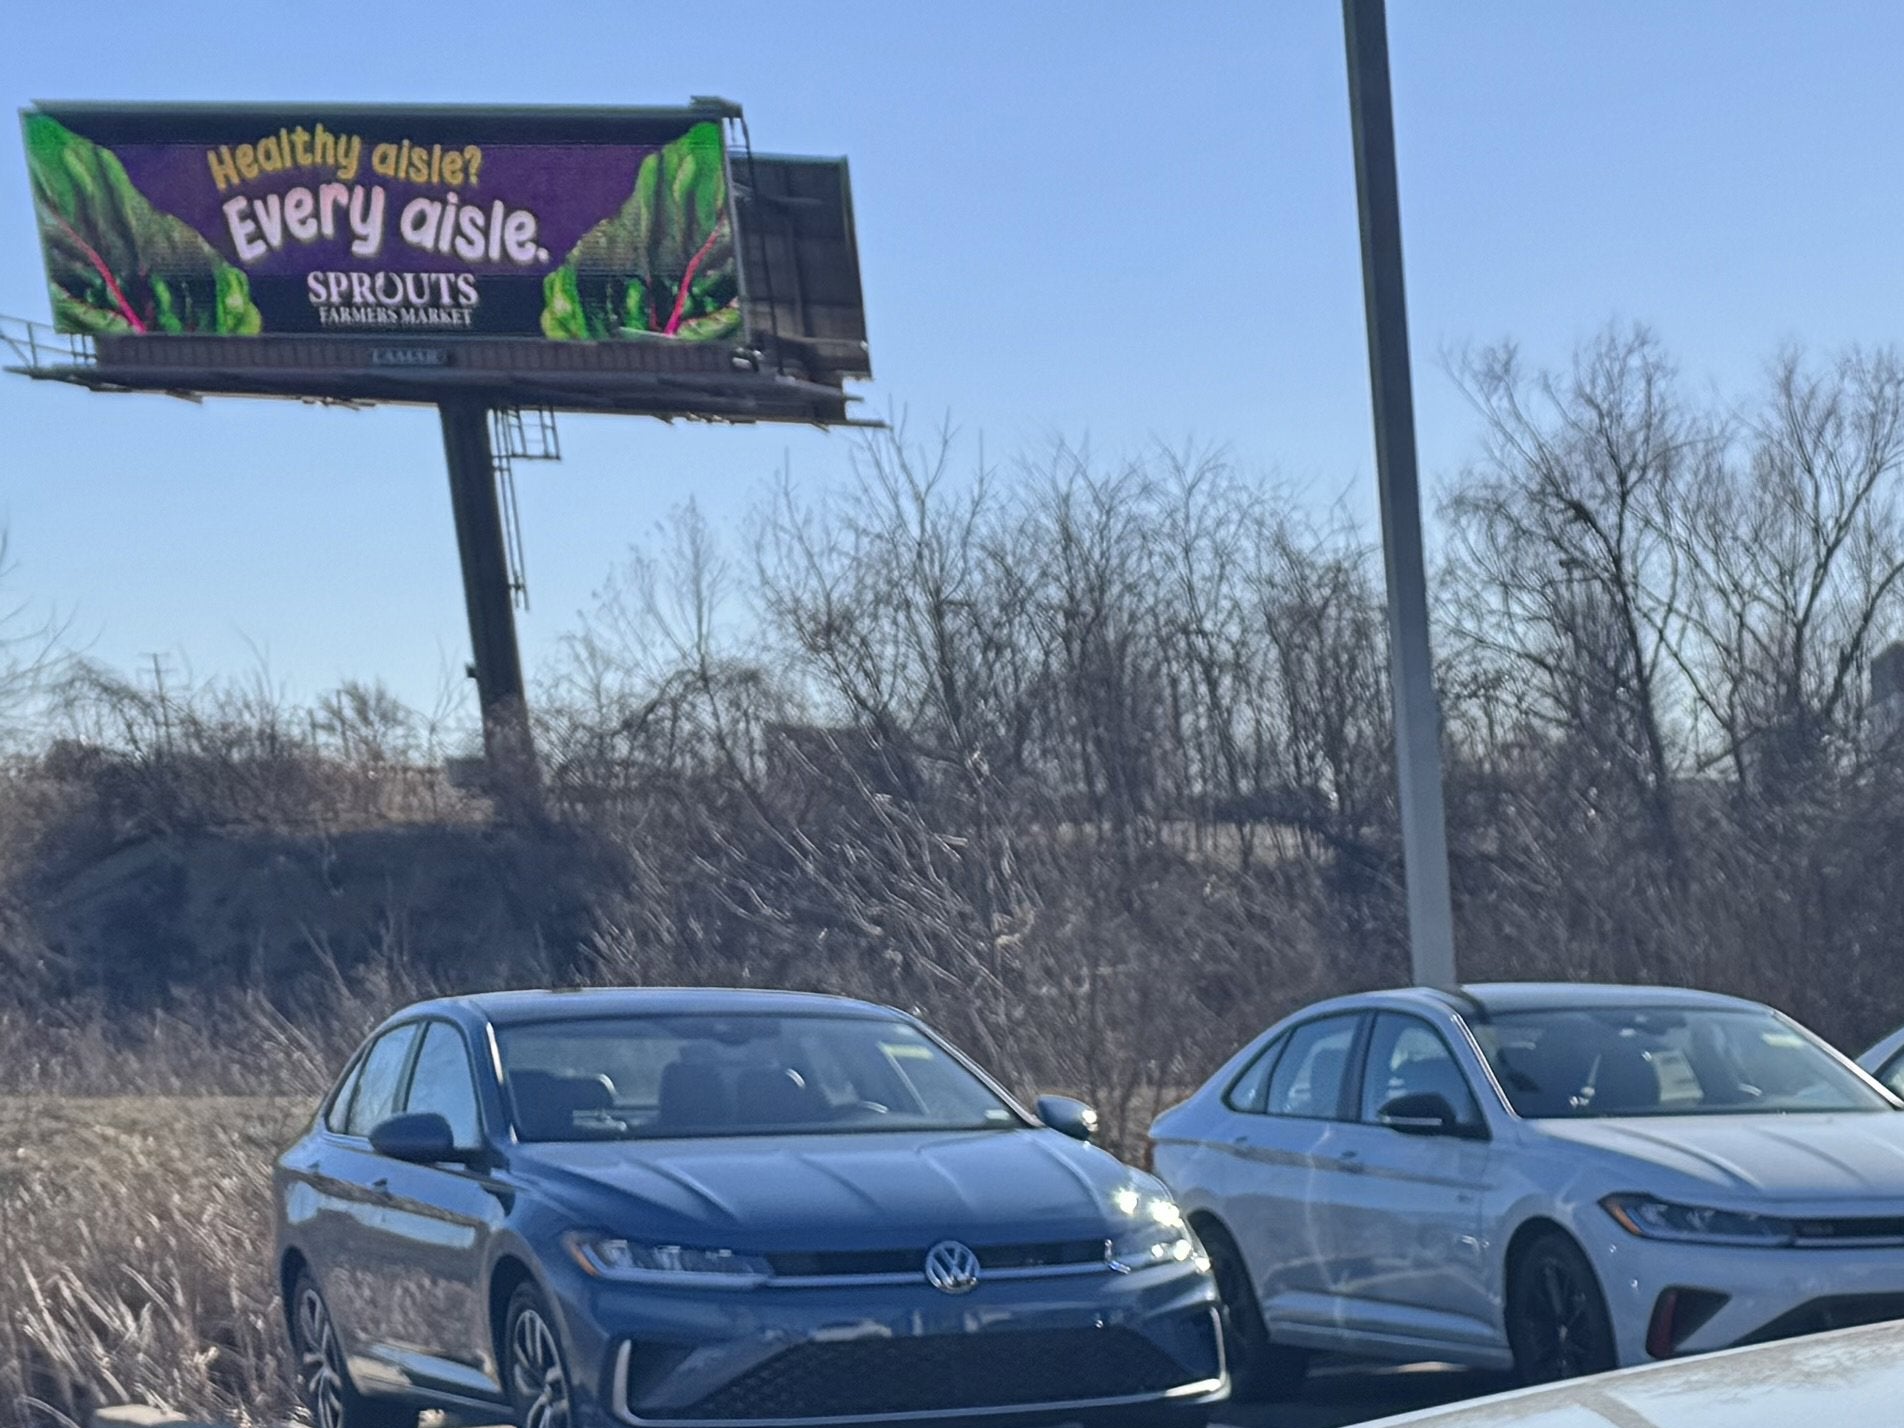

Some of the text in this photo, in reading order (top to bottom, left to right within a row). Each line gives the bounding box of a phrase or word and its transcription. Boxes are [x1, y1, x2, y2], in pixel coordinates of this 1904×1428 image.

[207, 122, 482, 192] Healthy aisle?
[222, 182, 550, 264] Every aisle.
[307, 270, 479, 307] SPROUTS
[319, 305, 473, 326] FARMERS MARKET
